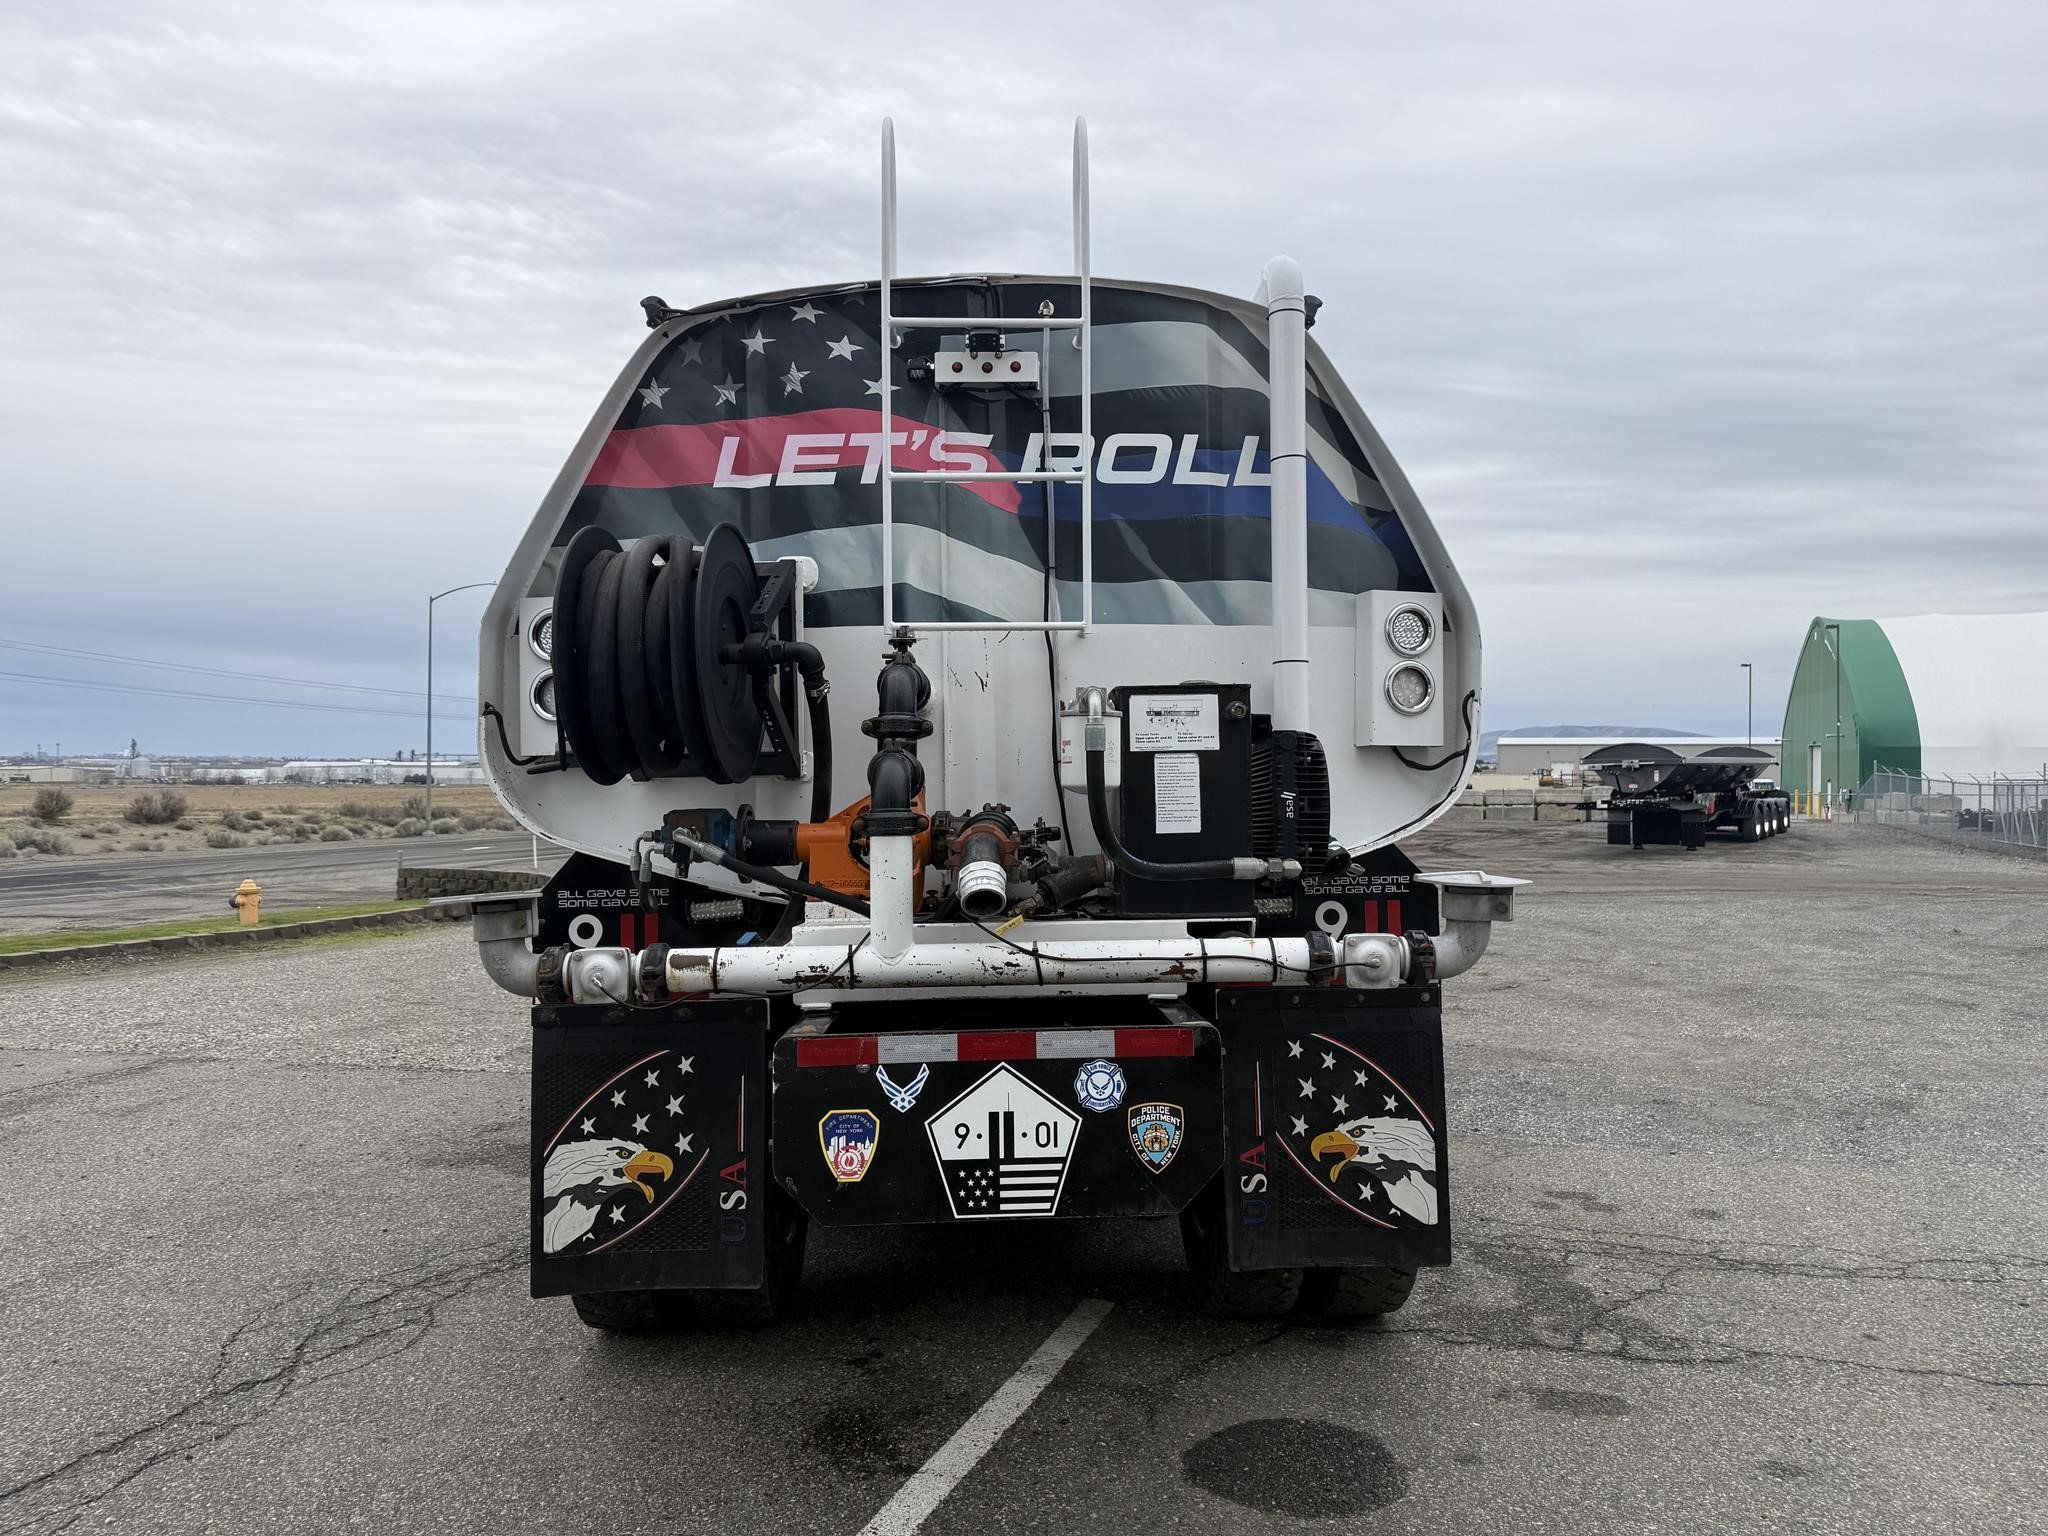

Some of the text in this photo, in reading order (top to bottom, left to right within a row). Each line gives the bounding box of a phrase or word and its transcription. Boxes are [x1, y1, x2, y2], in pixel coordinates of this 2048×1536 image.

[712, 430, 1272, 488] LET'S ROLL
[825, 1114, 873, 1131] FIRE DEPARTMENT
[1131, 1113, 1181, 1127] DEPARTMENT
[1141, 1105, 1170, 1115] POLICE
[1132, 1133, 1151, 1161] CITY OF
[1160, 1130, 1181, 1166] NEW YORK
[1239, 1141, 1267, 1225] USA
[719, 1158, 747, 1243] USA
